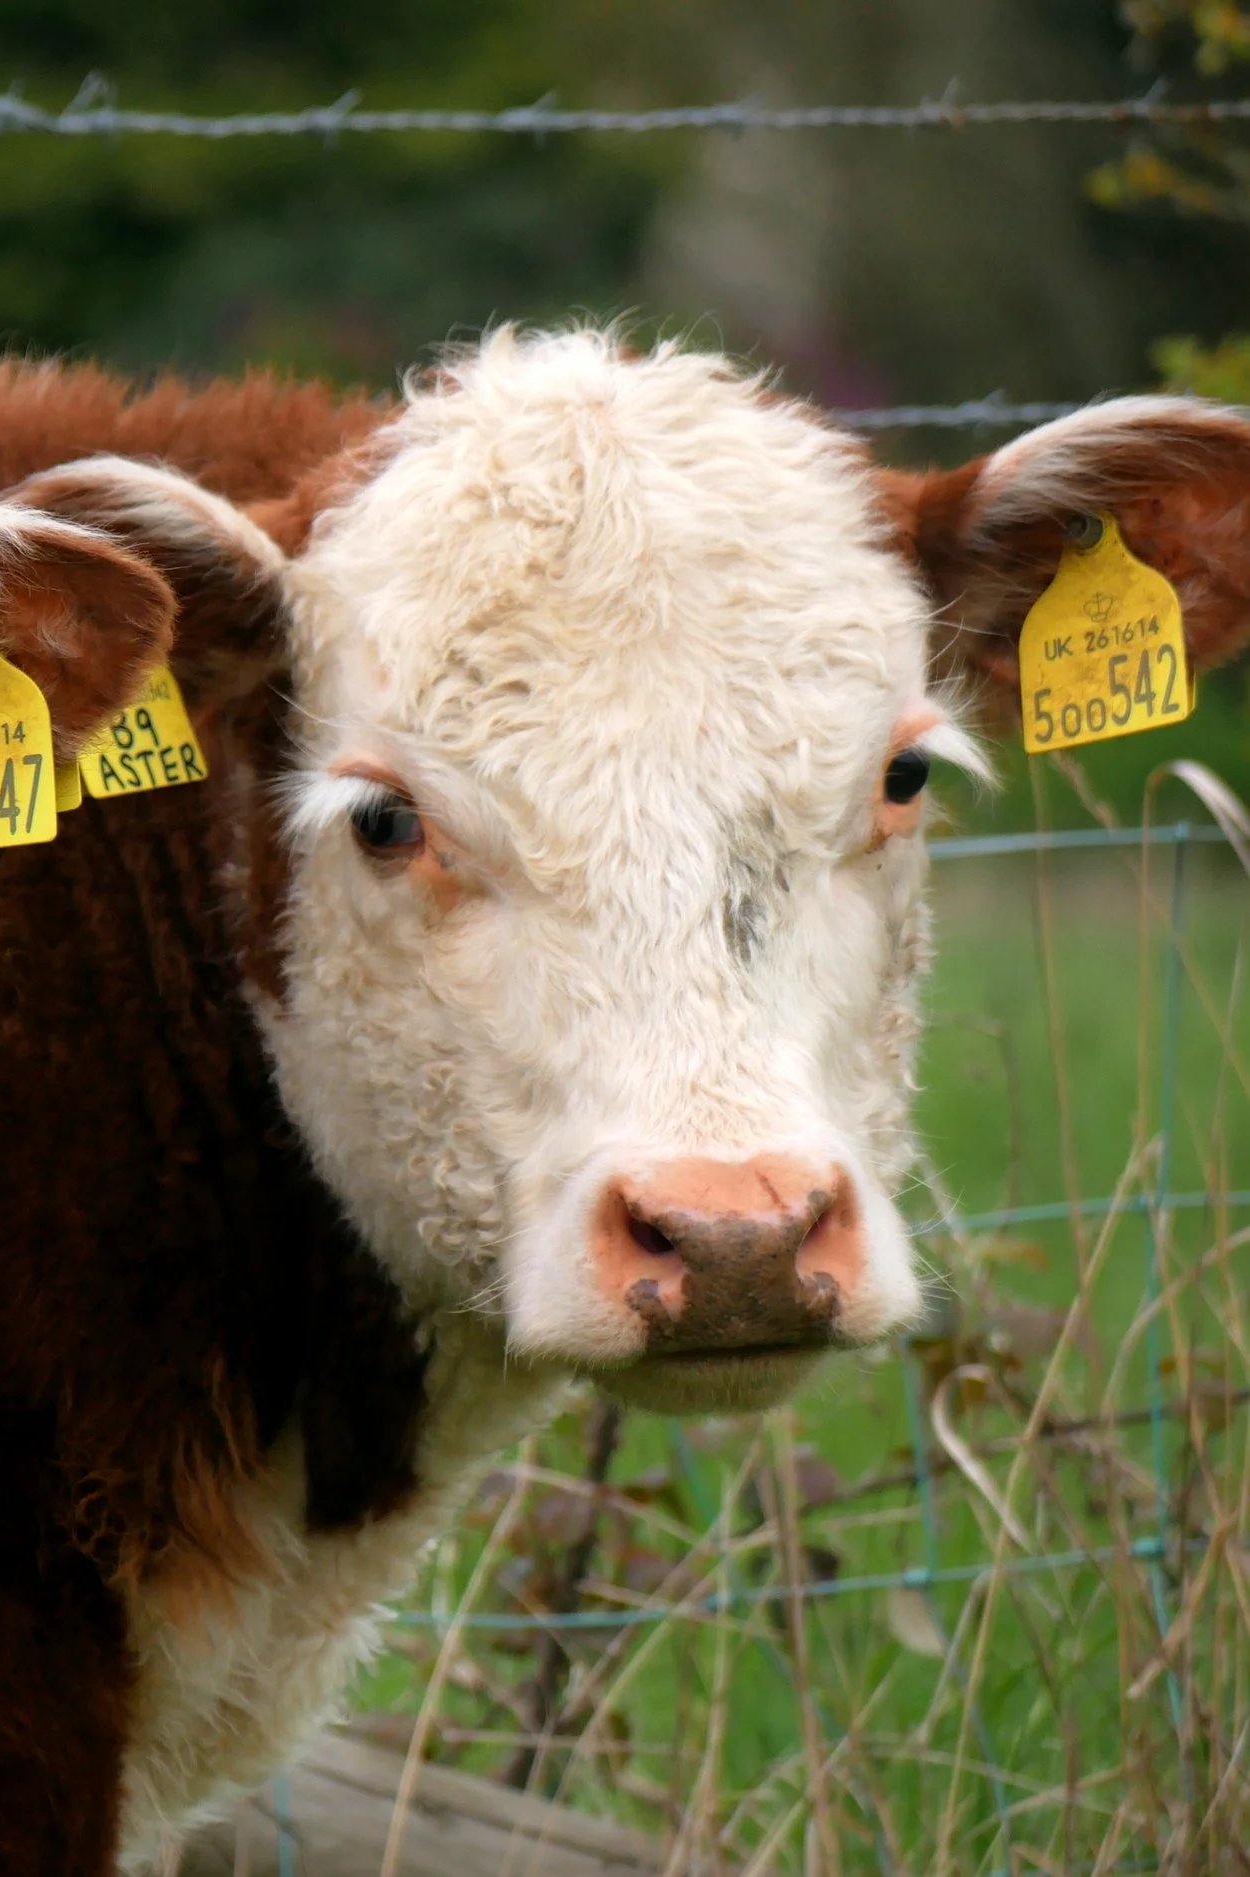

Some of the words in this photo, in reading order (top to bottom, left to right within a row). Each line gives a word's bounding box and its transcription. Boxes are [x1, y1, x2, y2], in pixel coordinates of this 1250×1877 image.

[1044, 635, 1073, 661] UK
[1084, 615, 1160, 654] 261614
[1034, 644, 1180, 744] 500542
[99, 743, 204, 792] ASTER
